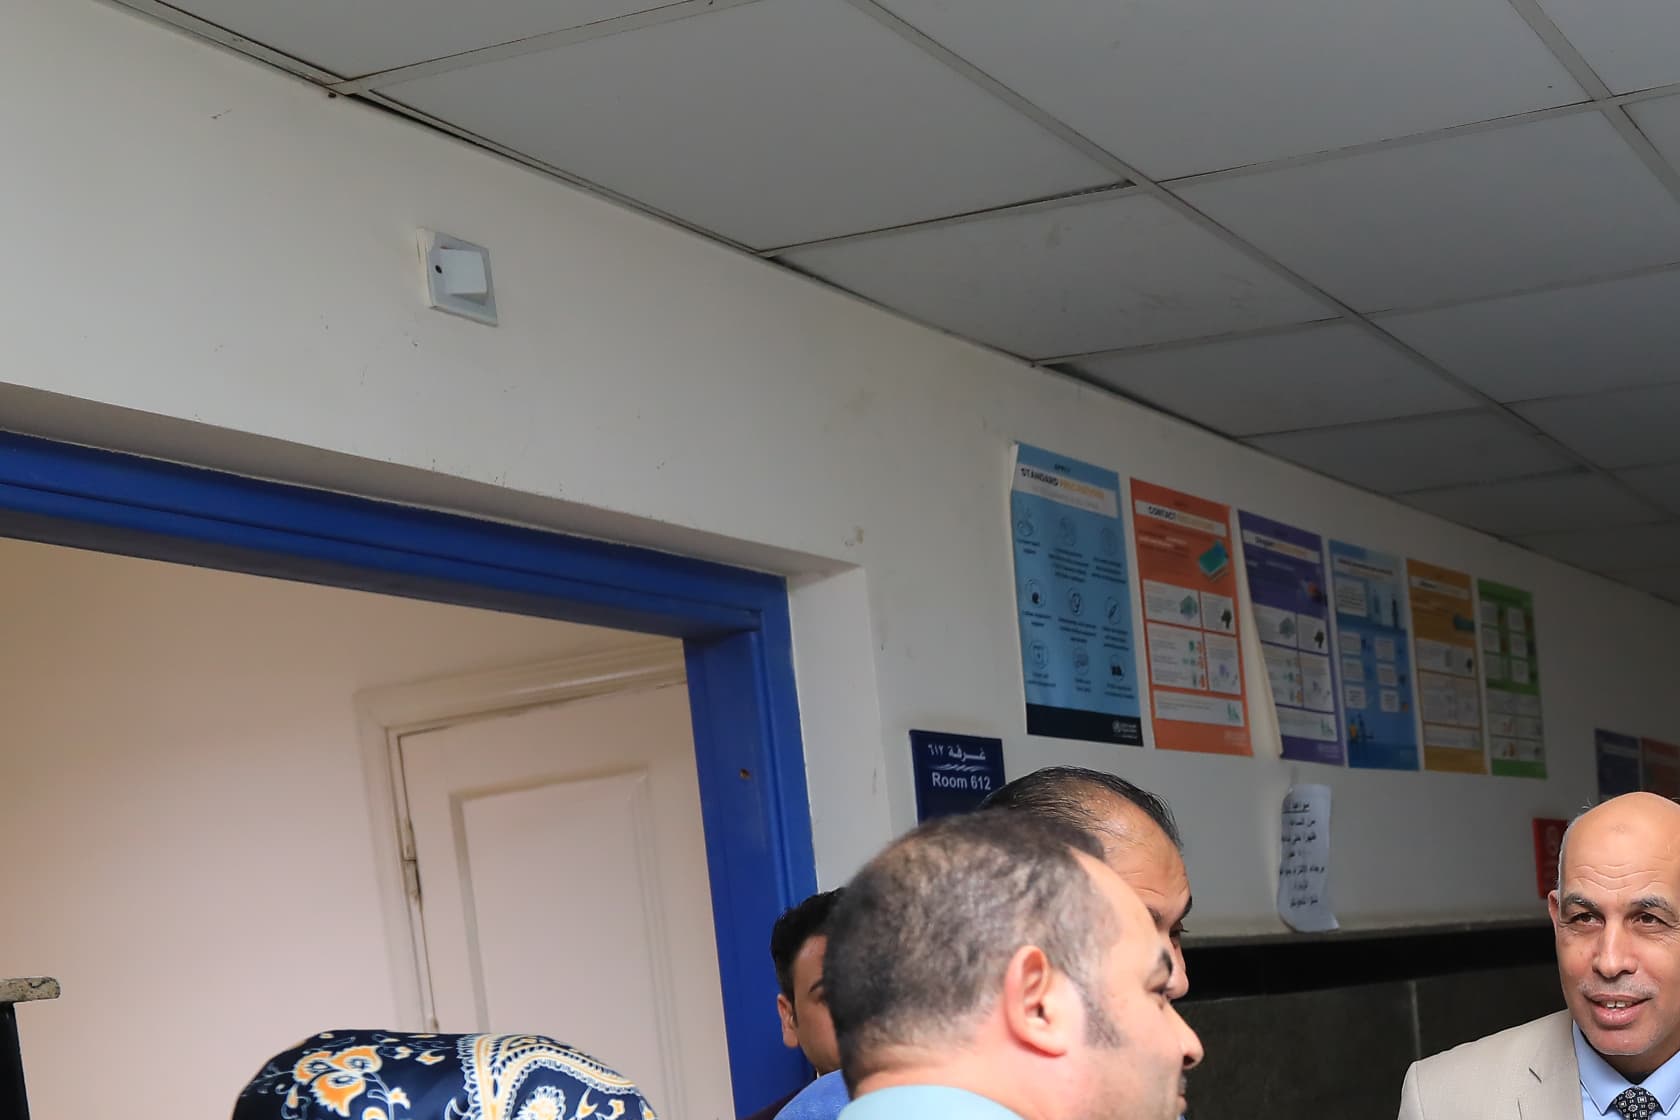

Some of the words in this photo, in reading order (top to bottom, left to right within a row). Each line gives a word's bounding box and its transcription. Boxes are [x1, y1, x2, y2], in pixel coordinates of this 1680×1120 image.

[947, 744, 986, 762] غرفة
[932, 772, 967, 789] Room
[970, 775, 992, 790] 612
